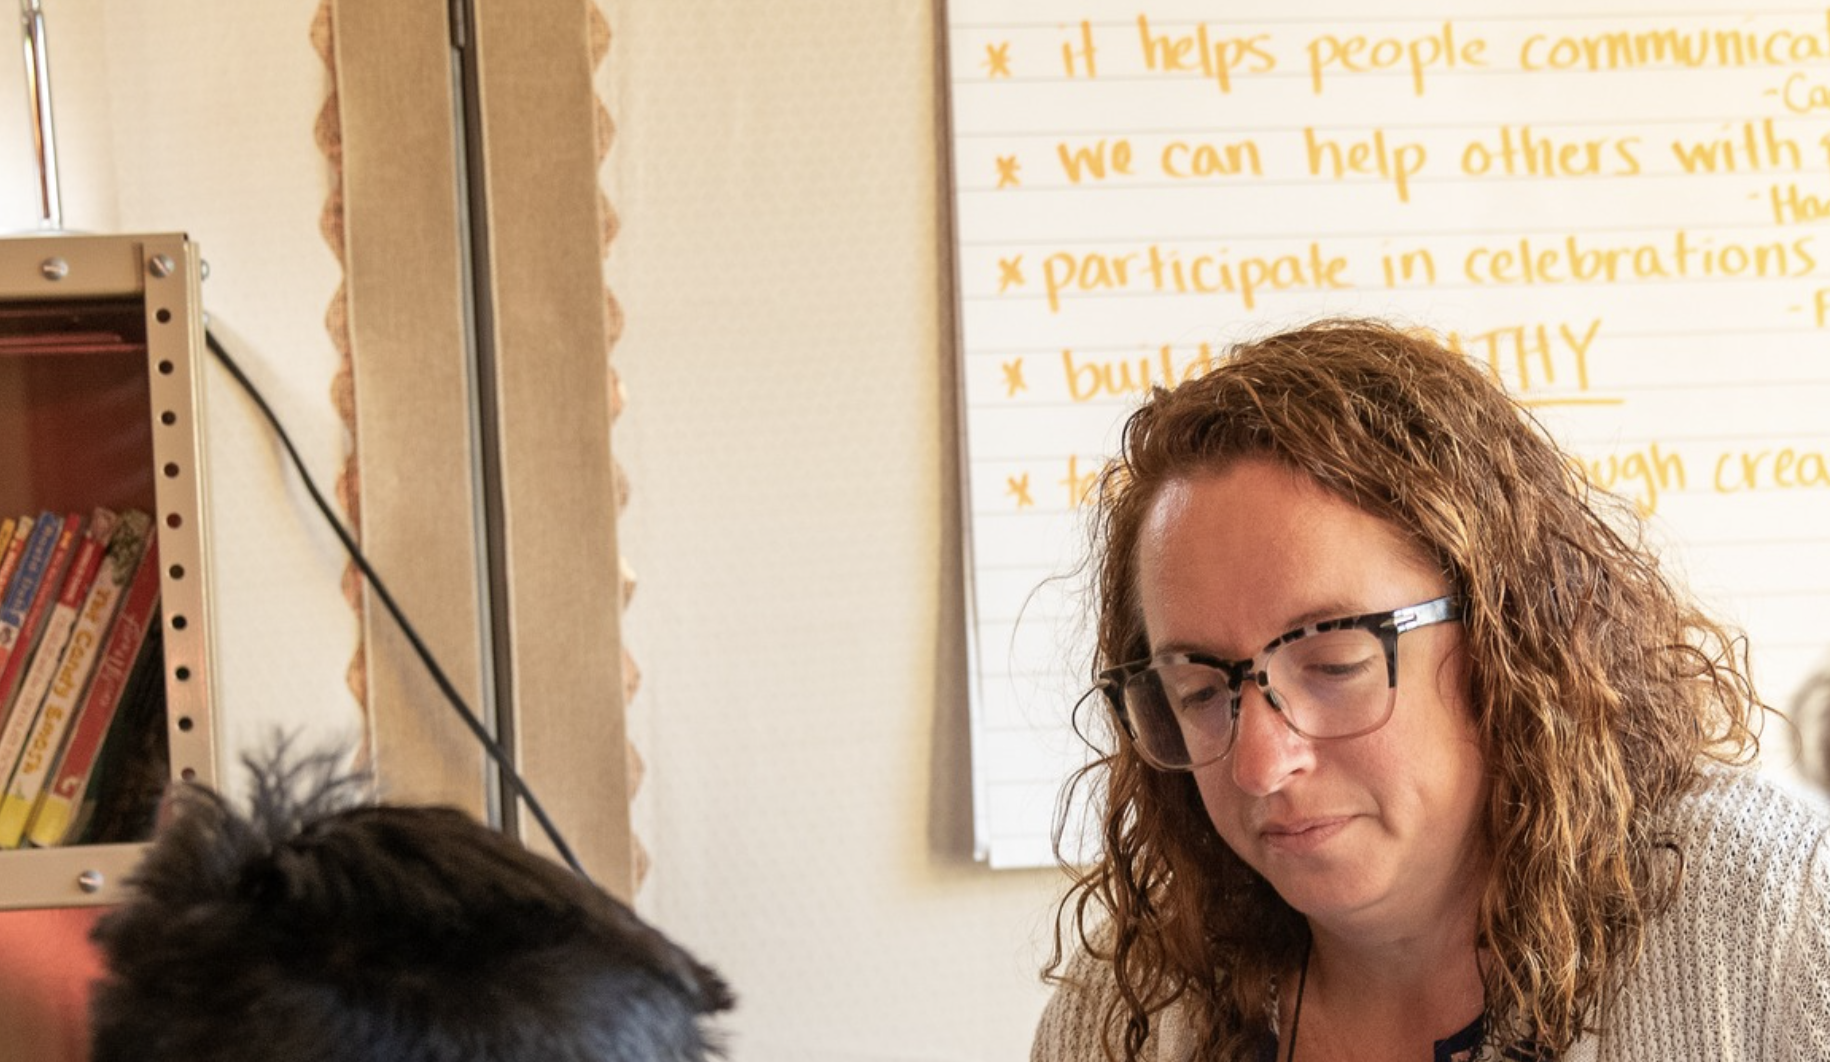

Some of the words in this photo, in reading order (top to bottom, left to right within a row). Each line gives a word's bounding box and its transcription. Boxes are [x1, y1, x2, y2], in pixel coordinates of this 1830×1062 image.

[1061, 20, 1097, 79] it
[1136, 13, 1277, 94] helps
[1306, 21, 1488, 96] people
[1056, 139, 1135, 184] we
[1161, 139, 1264, 179] can
[1303, 126, 1427, 203] help
[1461, 125, 1642, 177] others
[1671, 117, 1801, 174] with
[1042, 242, 1353, 313] participate
[1382, 241, 1436, 289] in
[1464, 229, 1817, 285] celebrations
